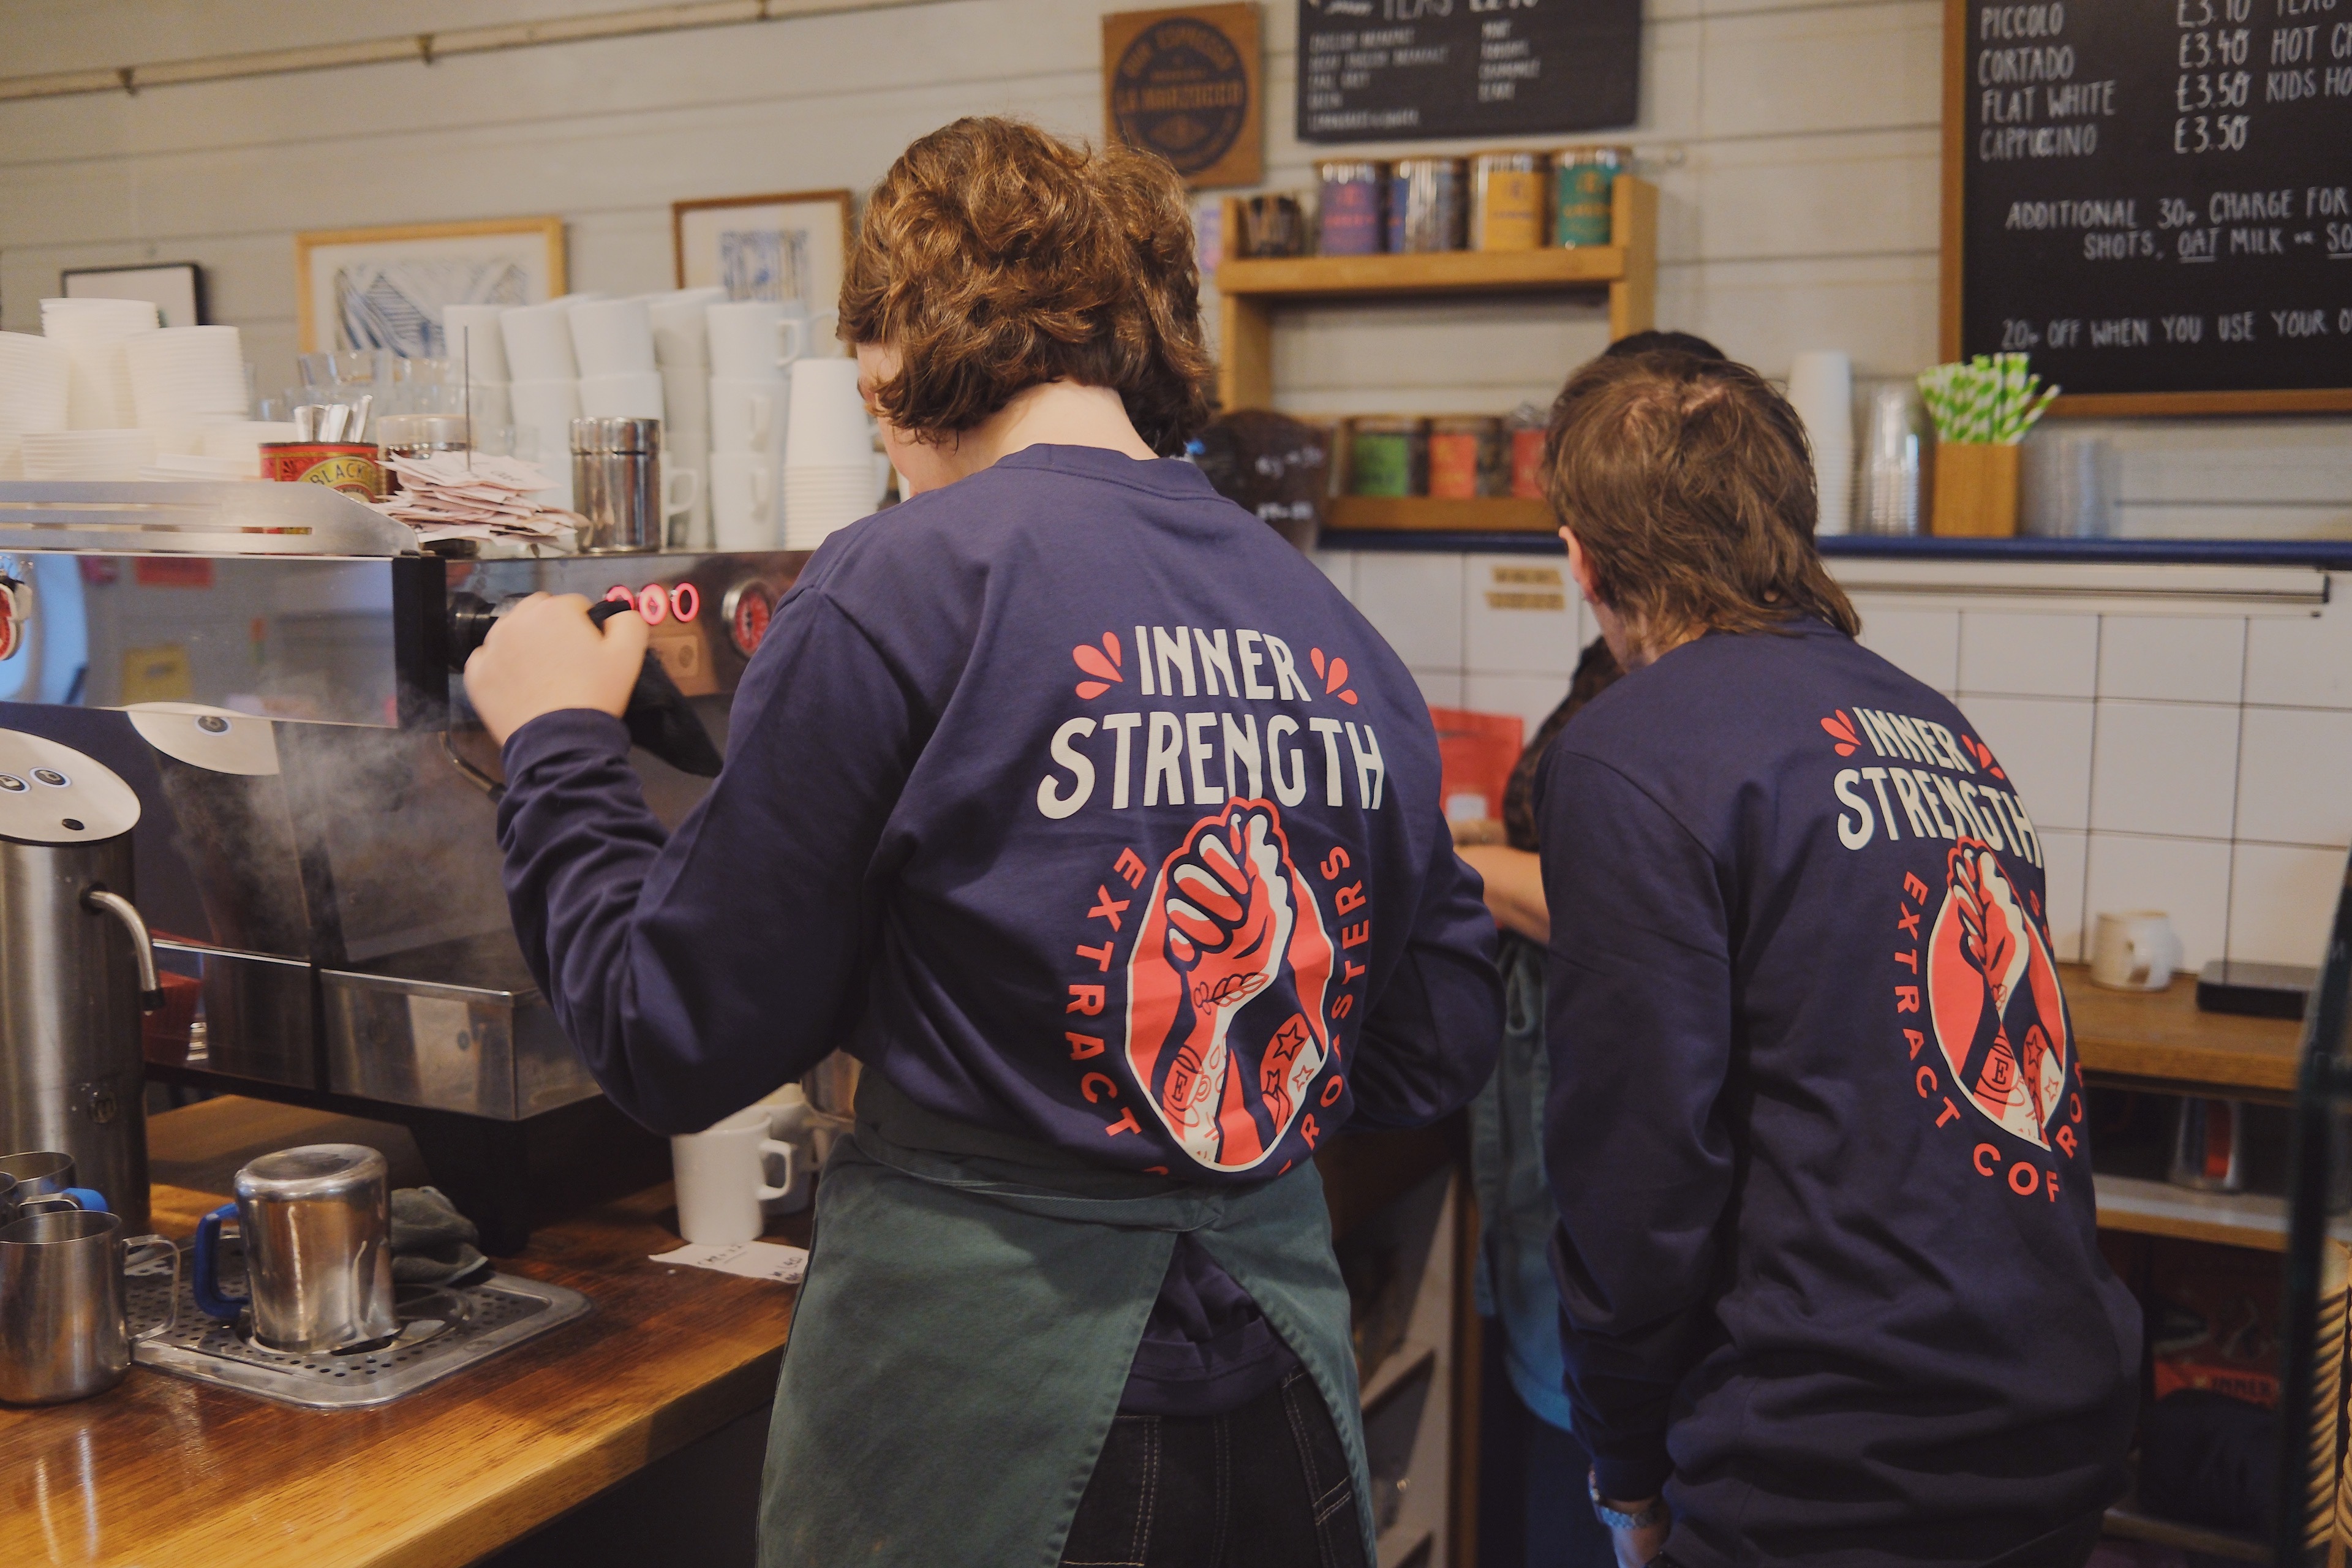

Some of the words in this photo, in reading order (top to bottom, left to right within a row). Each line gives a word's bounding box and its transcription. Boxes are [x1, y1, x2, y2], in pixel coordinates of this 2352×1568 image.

[1980, 2, 2064, 40] PICCOLO
[1978, 44, 2076, 87] CORTADO
[2179, 29, 2251, 69] £3.40
[2271, 25, 2320, 66] HOT
[1981, 85, 2036, 124] FLAT
[2046, 80, 2116, 118] WHITE
[2176, 70, 2252, 113] £3.50
[2266, 67, 2316, 104] KIDS
[2174, 115, 2250, 154] £3.50
[2005, 198, 2140, 230] ADDITIONAL
[2209, 189, 2293, 225] CHARGE
[2306, 186, 2350, 219] FOR
[2177, 227, 2222, 258] OAT
[2230, 227, 2284, 255] MILK
[2046, 318, 2081, 349] OFF
[2090, 317, 2149, 348] WHEN
[2161, 314, 2203, 344] YOU
[2217, 311, 2256, 342] USE
[2269, 309, 2329, 338] YOUR
[1135, 625, 1311, 701] INNER
[1852, 707, 1976, 774] INNER
[1036, 711, 1384, 820] STRENGTH
[1833, 766, 2045, 869] STRENGTH
[1065, 847, 1147, 1137] EXTRACT
[1300, 846, 1369, 1151] ROSTERS
[1894, 871, 1961, 1128] EXTRACT
